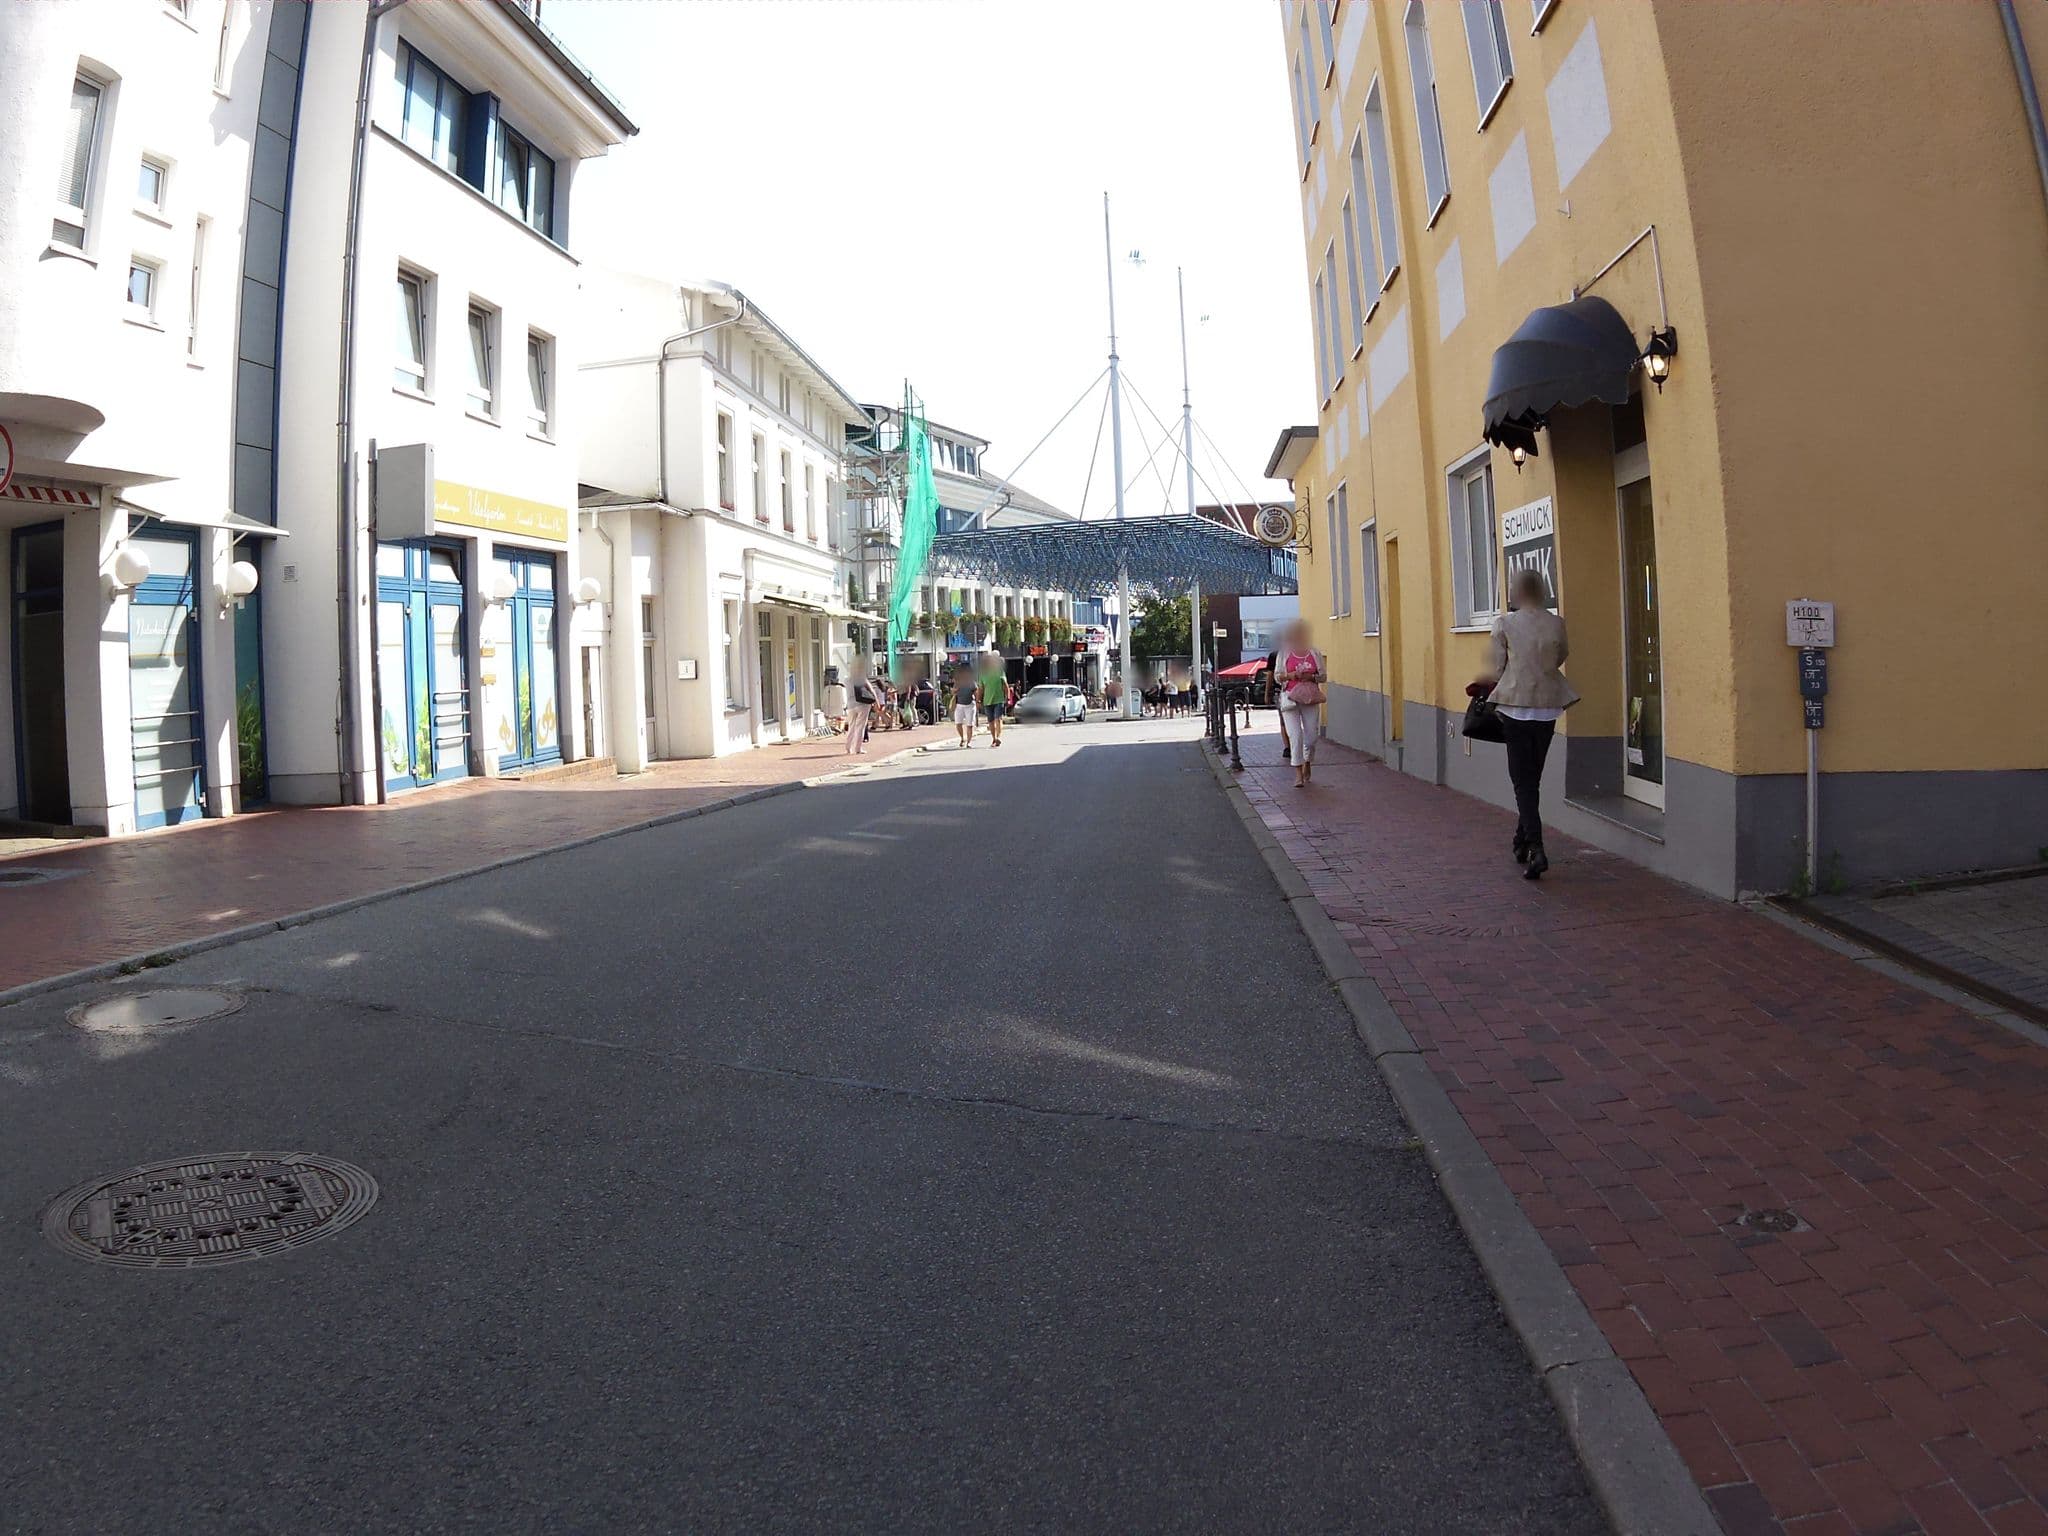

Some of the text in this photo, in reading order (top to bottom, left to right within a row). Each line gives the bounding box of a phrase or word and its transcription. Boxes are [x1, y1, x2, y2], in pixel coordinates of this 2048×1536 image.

[1504, 504, 1551, 539] SCHMUCK
[1793, 606, 1820, 617] H100
[1805, 655, 1813, 666] S
